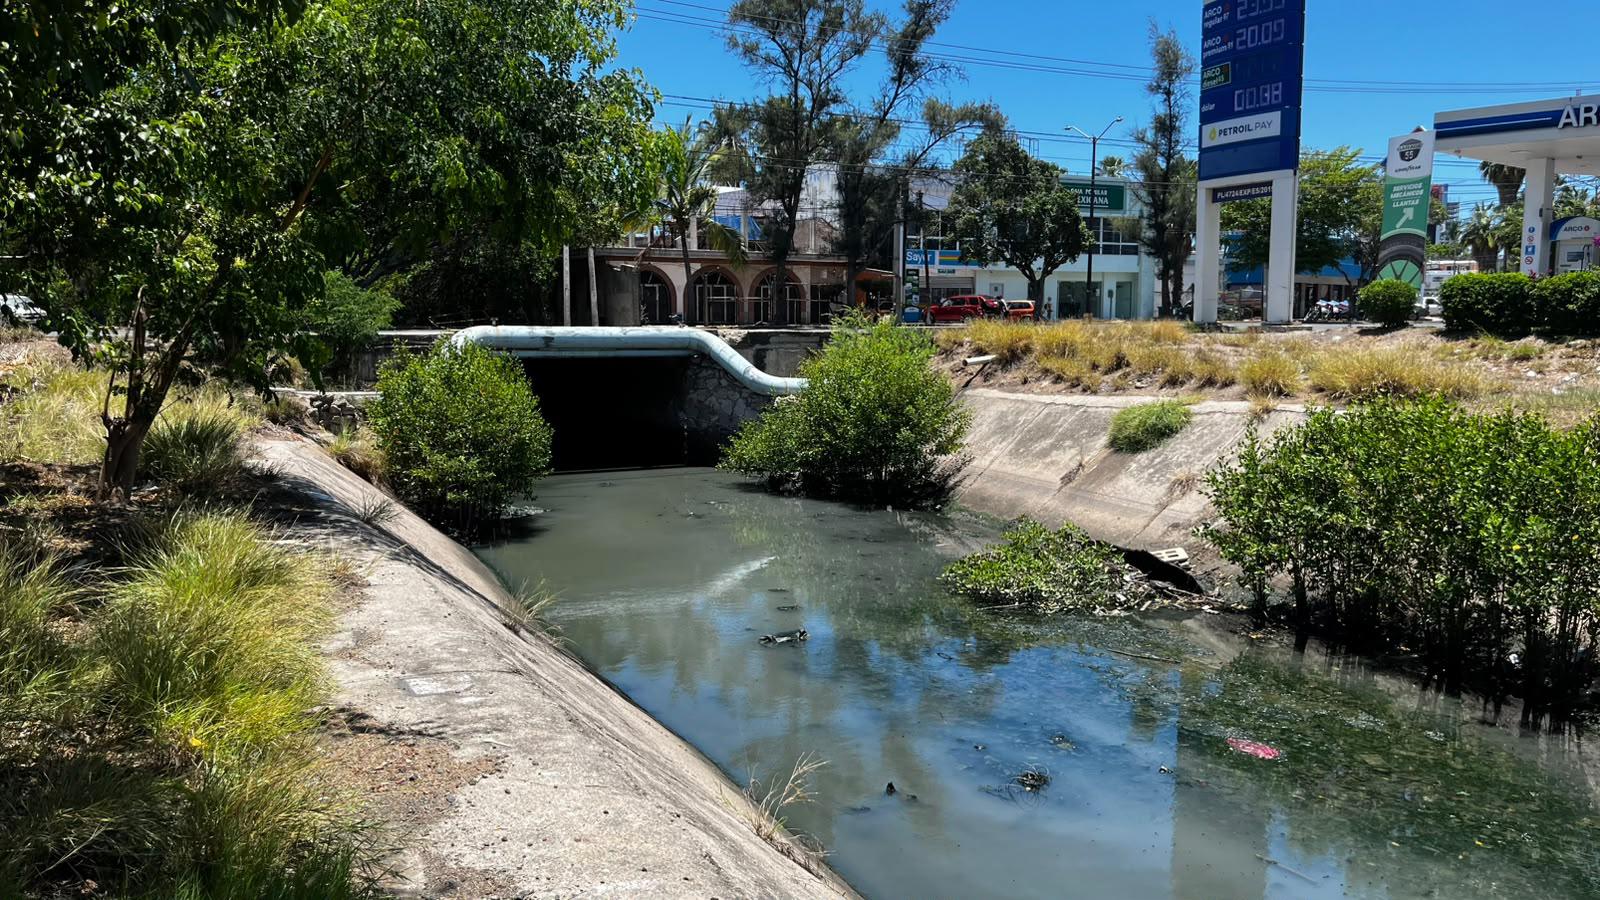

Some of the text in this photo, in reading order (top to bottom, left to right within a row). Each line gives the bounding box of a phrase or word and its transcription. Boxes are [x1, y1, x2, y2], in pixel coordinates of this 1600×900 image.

[1204, 6, 1222, 18] ARCO
[1204, 16, 1222, 28] regular
[1236, 18, 1284, 50] 20.09
[1203, 36, 1221, 49] ARCO
[1203, 45, 1227, 59] premium
[1203, 68, 1220, 79] ARCO
[1218, 119, 1273, 137] PETROIL PAY
[1405, 151, 1413, 159] 55
[1393, 199, 1419, 208] LLANTAS
